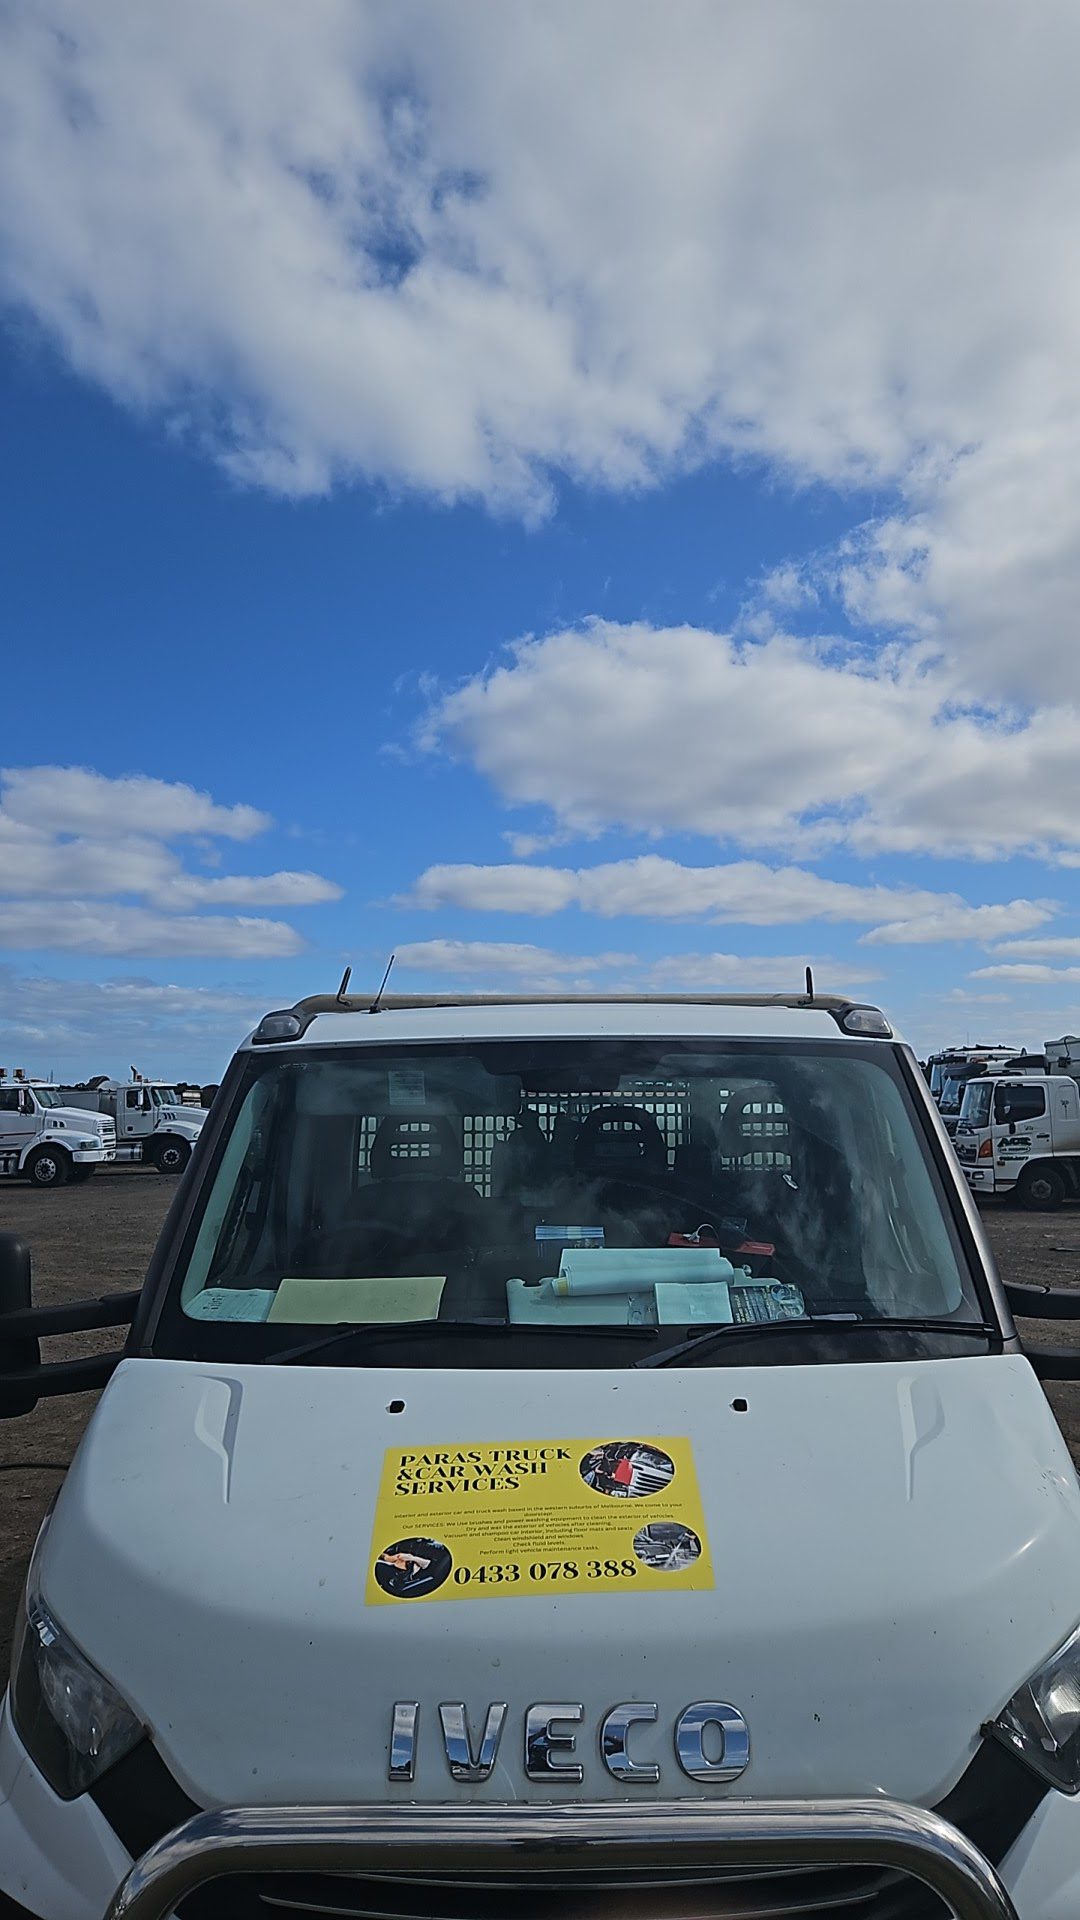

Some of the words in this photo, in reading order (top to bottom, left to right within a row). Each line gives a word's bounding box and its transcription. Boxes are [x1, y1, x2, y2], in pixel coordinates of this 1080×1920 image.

[400, 1451, 481, 1467] PARAS
[489, 1448, 571, 1462] TRUCK
[397, 1466, 465, 1481] &CAR
[474, 1462, 547, 1476] WASH
[395, 1477, 519, 1496] SERVICES
[512, 1540, 531, 1548] Check
[520, 1546, 542, 1554] vehicle
[453, 1564, 521, 1585] 0433
[529, 1562, 580, 1581] 078
[586, 1560, 637, 1578] 388
[388, 1701, 751, 1784] IVECO
